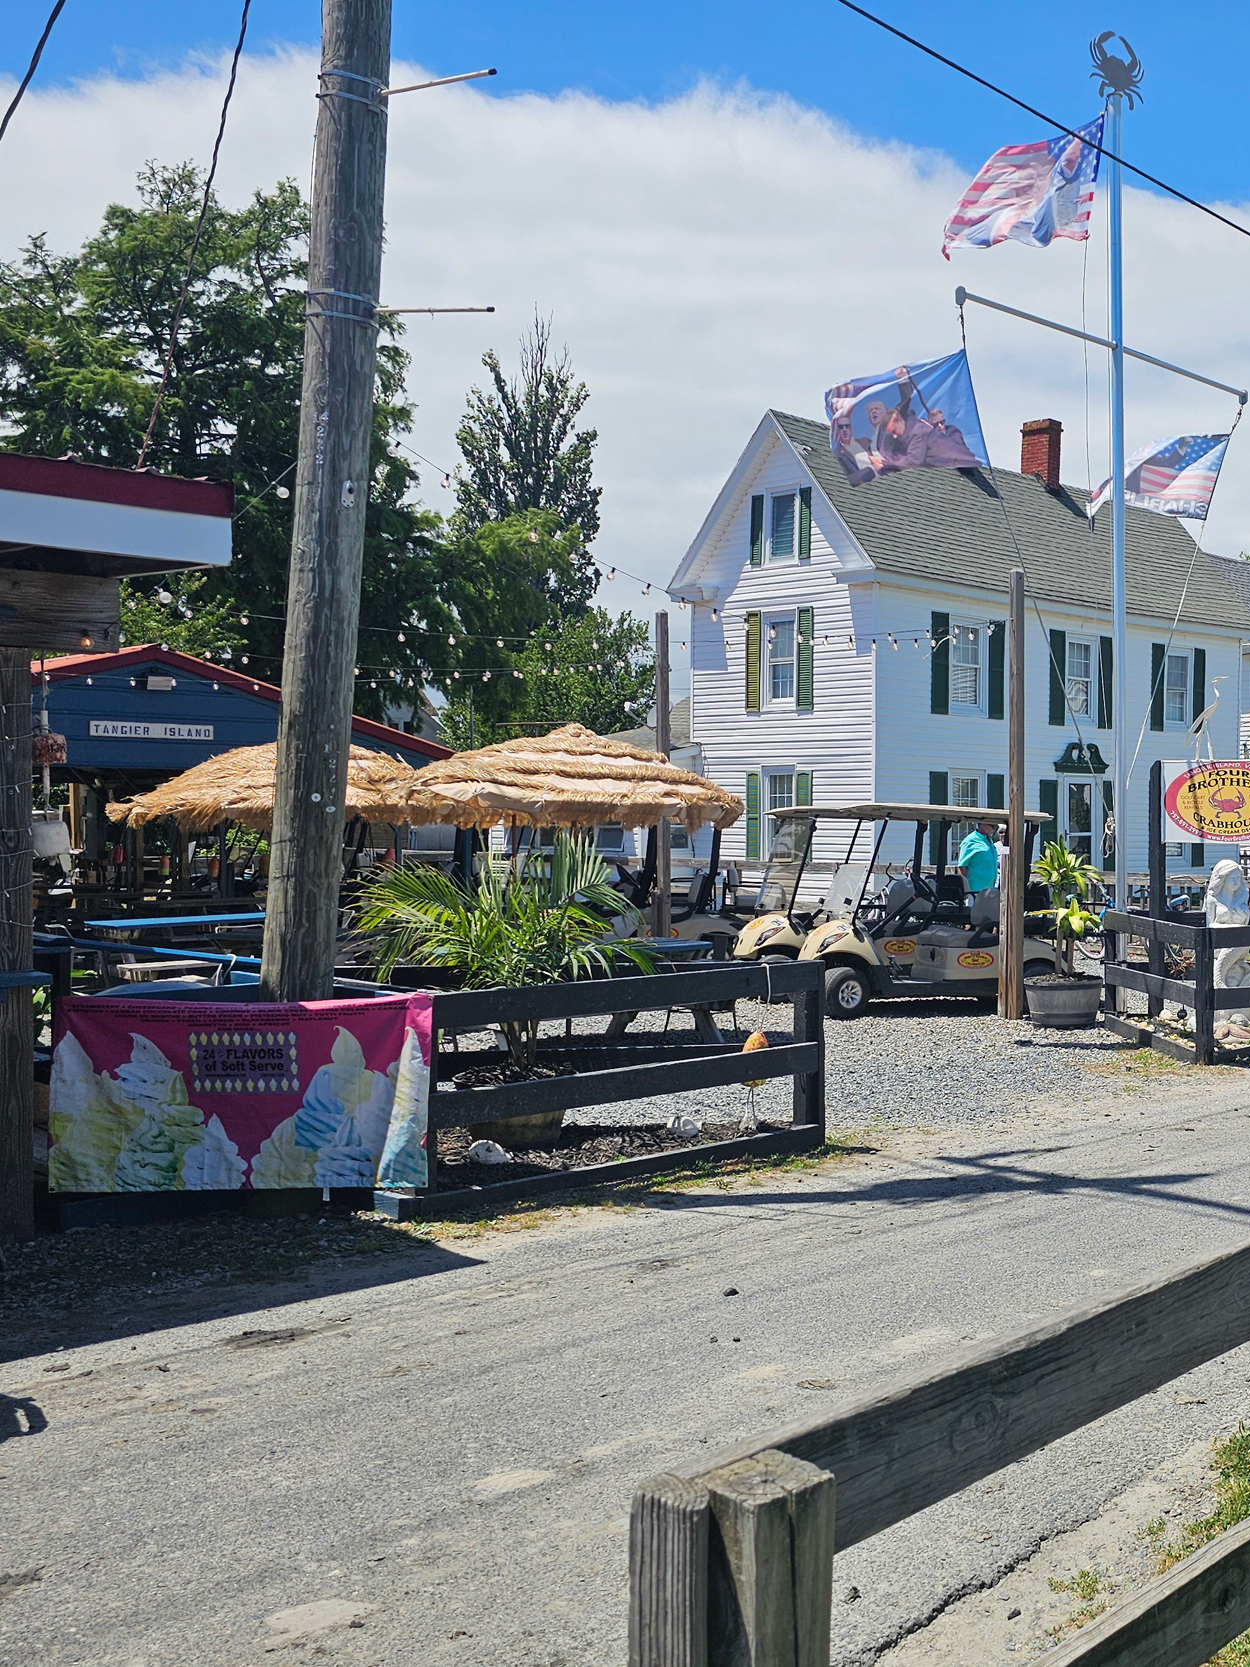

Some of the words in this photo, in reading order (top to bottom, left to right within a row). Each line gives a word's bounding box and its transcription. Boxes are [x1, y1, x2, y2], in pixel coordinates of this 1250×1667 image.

[94, 724, 150, 735] TANGIER
[164, 727, 211, 738] ISLAND
[1208, 769, 1250, 778] FOUR
[203, 1049, 216, 1060] 24
[226, 1048, 284, 1060] FLAVORS
[205, 1061, 217, 1071] of
[221, 1061, 246, 1071] Soft
[249, 1060, 285, 1071] Serve
